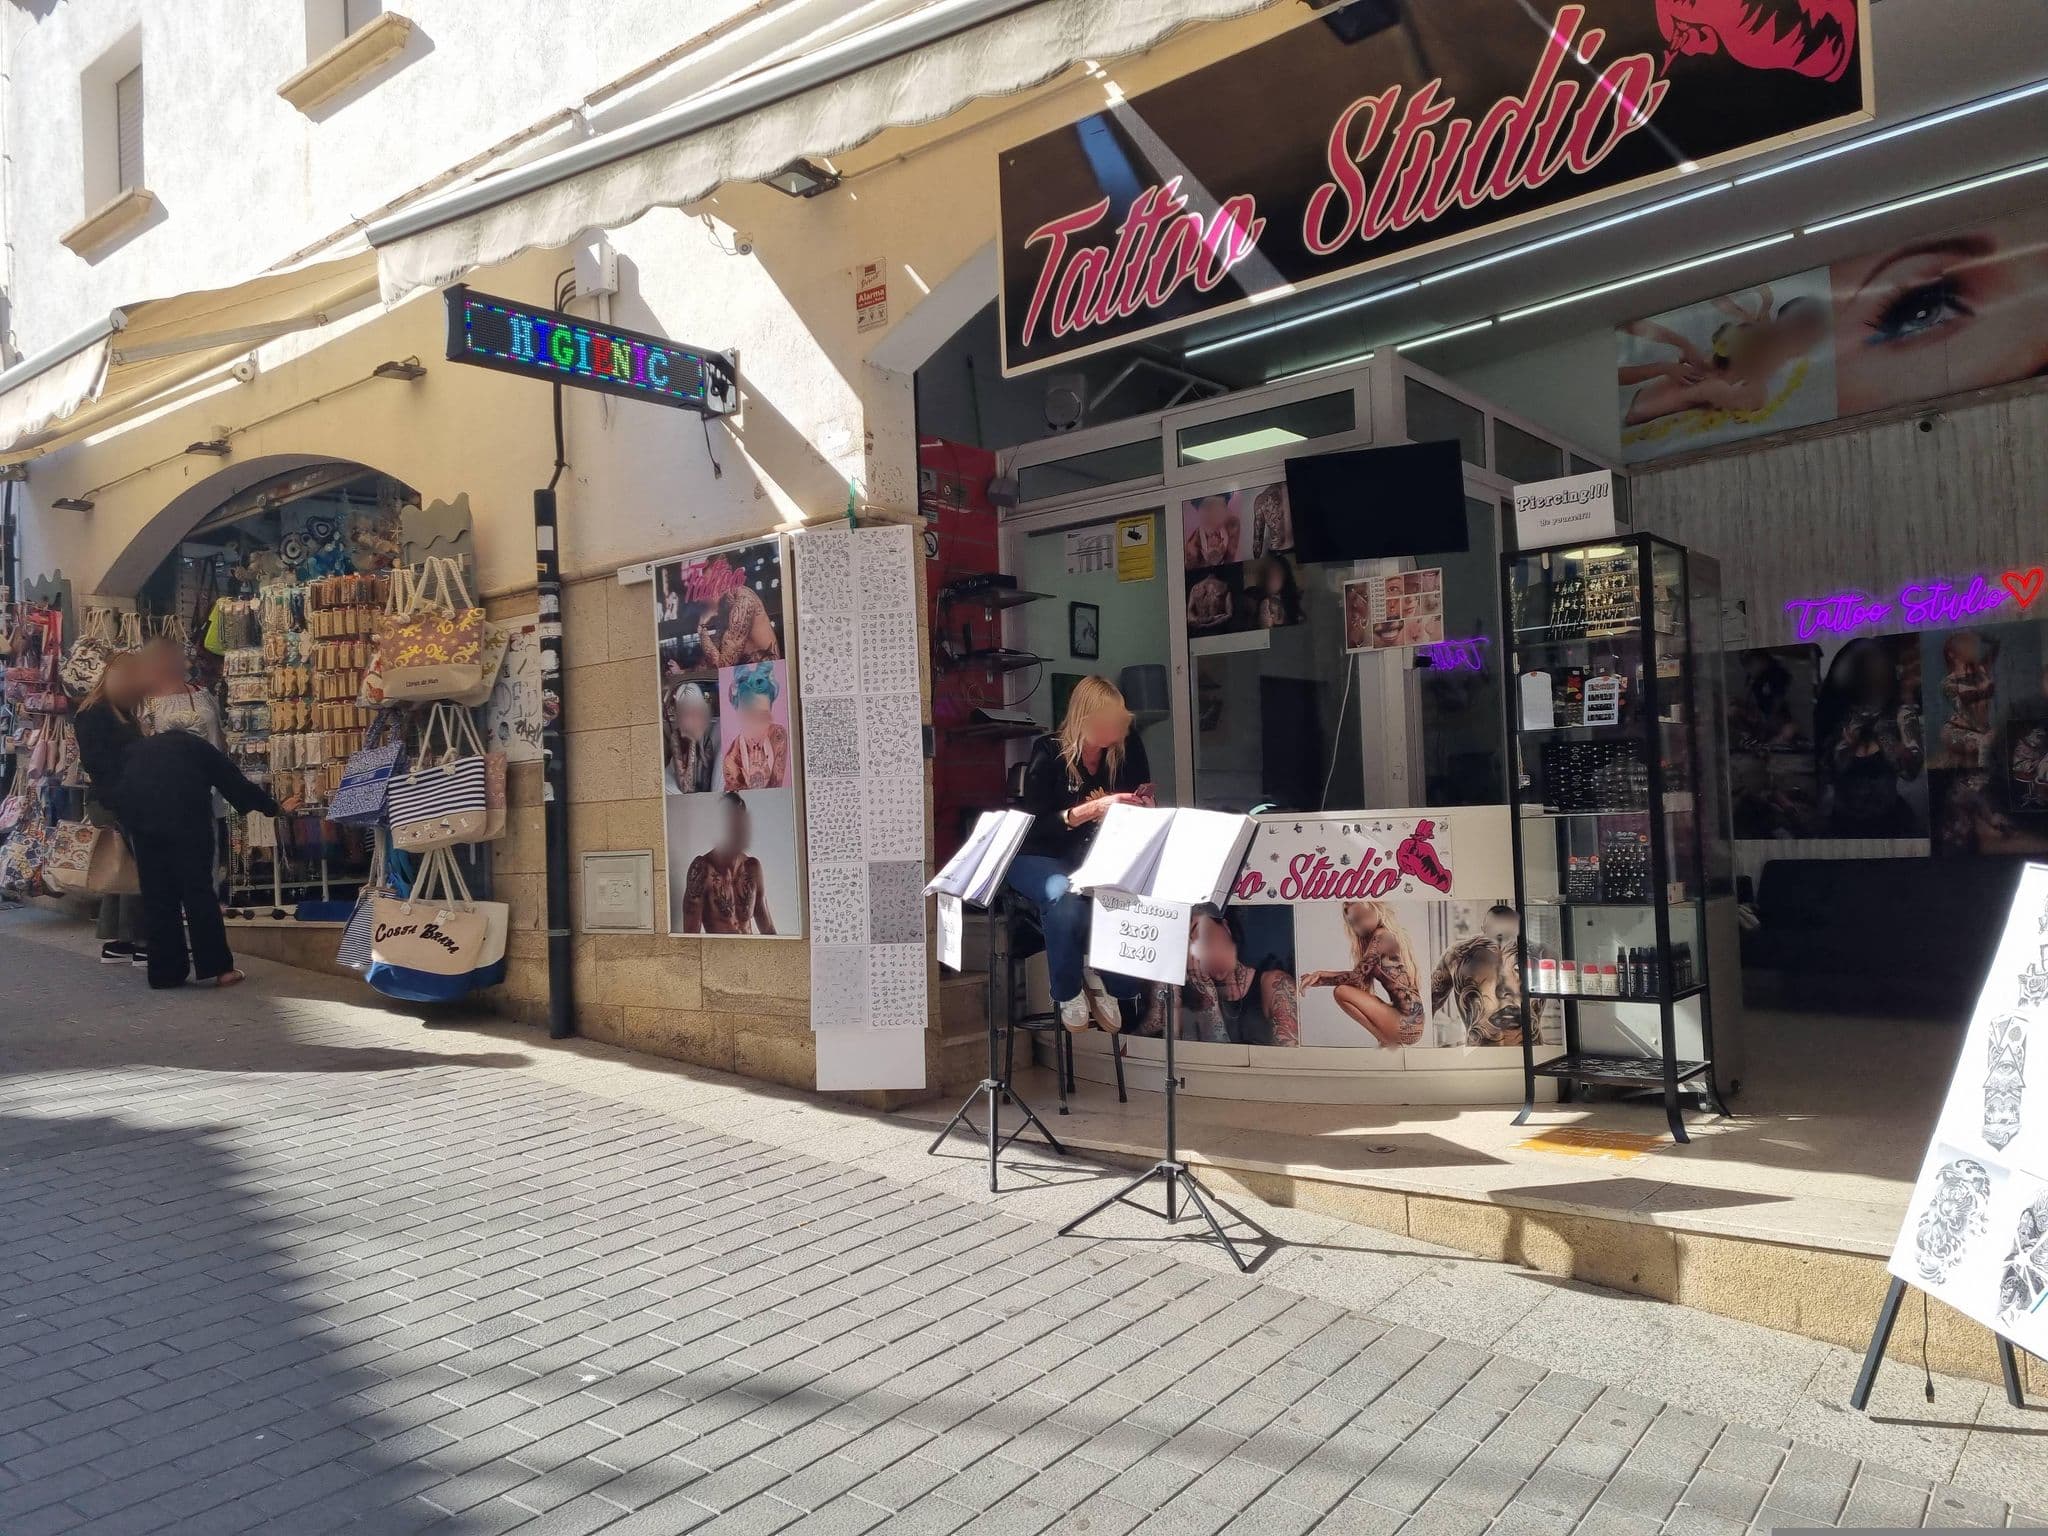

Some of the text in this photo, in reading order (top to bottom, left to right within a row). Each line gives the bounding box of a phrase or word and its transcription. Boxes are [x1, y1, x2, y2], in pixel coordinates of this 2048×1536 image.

[1022, 4, 1670, 346] Tattoo Studio
[857, 288, 886, 304] Alarma
[509, 315, 670, 388] HIGIENIC
[1517, 482, 1609, 512] Piercing!!!
[1784, 576, 2011, 640] Tattoo Studio
[1280, 847, 1402, 900] Studio
[1102, 894, 1131, 911] Mini
[1119, 920, 1159, 941] 2x60
[1119, 941, 1157, 963] 1x40
